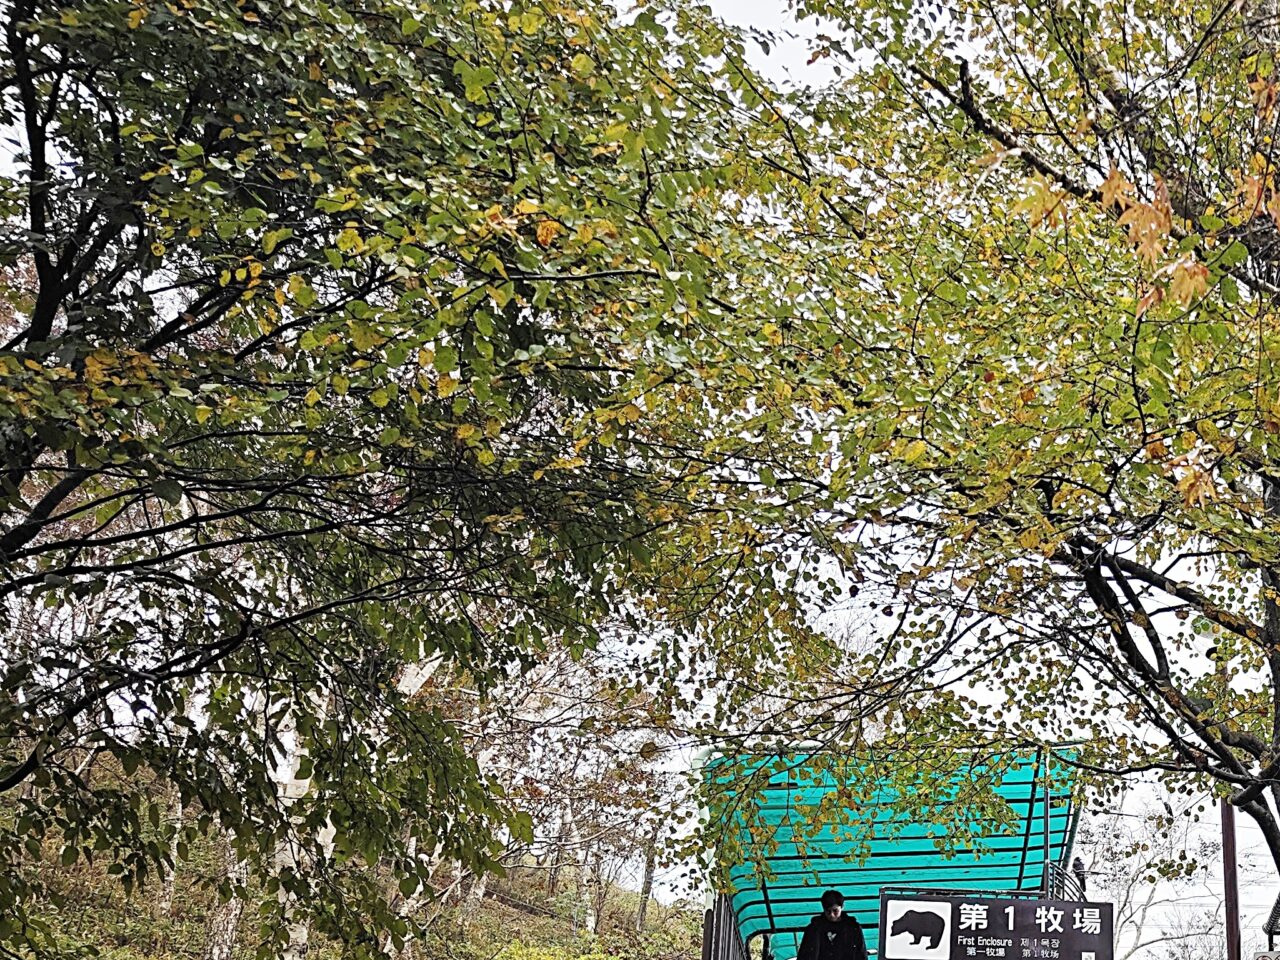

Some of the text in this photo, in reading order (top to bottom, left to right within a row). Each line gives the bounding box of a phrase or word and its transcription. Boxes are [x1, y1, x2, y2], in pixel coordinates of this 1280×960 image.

[958, 903, 1101, 935] 第1牧場
[957, 935, 1013, 947] First Enclosure
